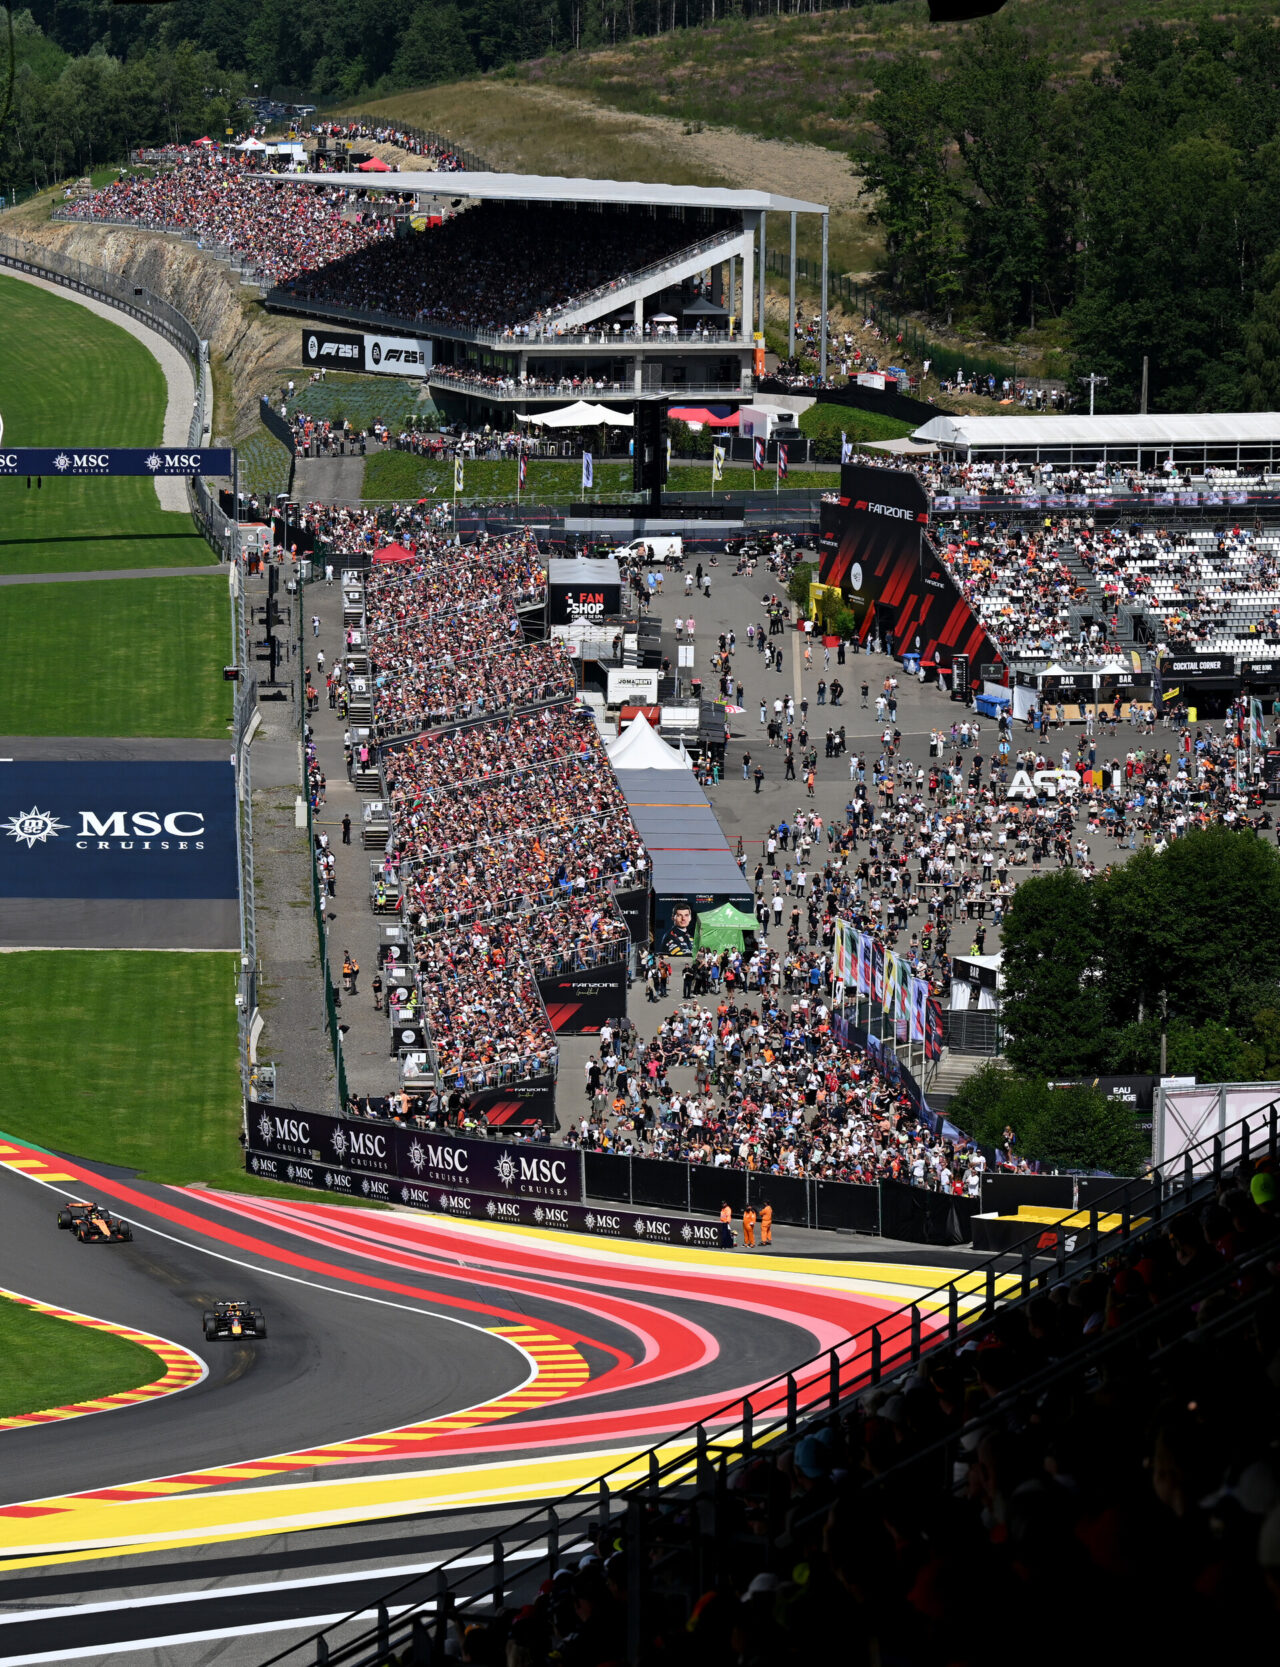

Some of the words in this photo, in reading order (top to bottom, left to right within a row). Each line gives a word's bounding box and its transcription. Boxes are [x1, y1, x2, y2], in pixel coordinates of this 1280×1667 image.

[72, 454, 109, 467] MSC
[164, 454, 201, 467] MSC
[868, 502, 913, 520] FANZONE
[580, 593, 604, 603] FAN
[571, 603, 604, 614] SHOP
[77, 811, 205, 837] MSC
[76, 841, 204, 850] CRUISES
[970, 965, 979, 978] BAR
[275, 1117, 310, 1144] MSC
[276, 1143, 312, 1156] CRUISES
[349, 1131, 386, 1158] MSC
[351, 1157, 388, 1170] CRUISES
[427, 1144, 468, 1172] MSC
[260, 1159, 277, 1172] MSC
[520, 1157, 567, 1184] MSC
[295, 1166, 313, 1180] MSC
[430, 1171, 469, 1184] CRUISES
[334, 1174, 352, 1187] MSC
[371, 1181, 389, 1194] MSC
[520, 1185, 568, 1196] CRUISES
[410, 1188, 429, 1202] MSC
[449, 1195, 470, 1210] MSC
[497, 1202, 520, 1216] MSC
[545, 1208, 568, 1221] MSC
[596, 1215, 620, 1228] MSC
[646, 1220, 670, 1234] MSC
[694, 1226, 718, 1239] MSC
